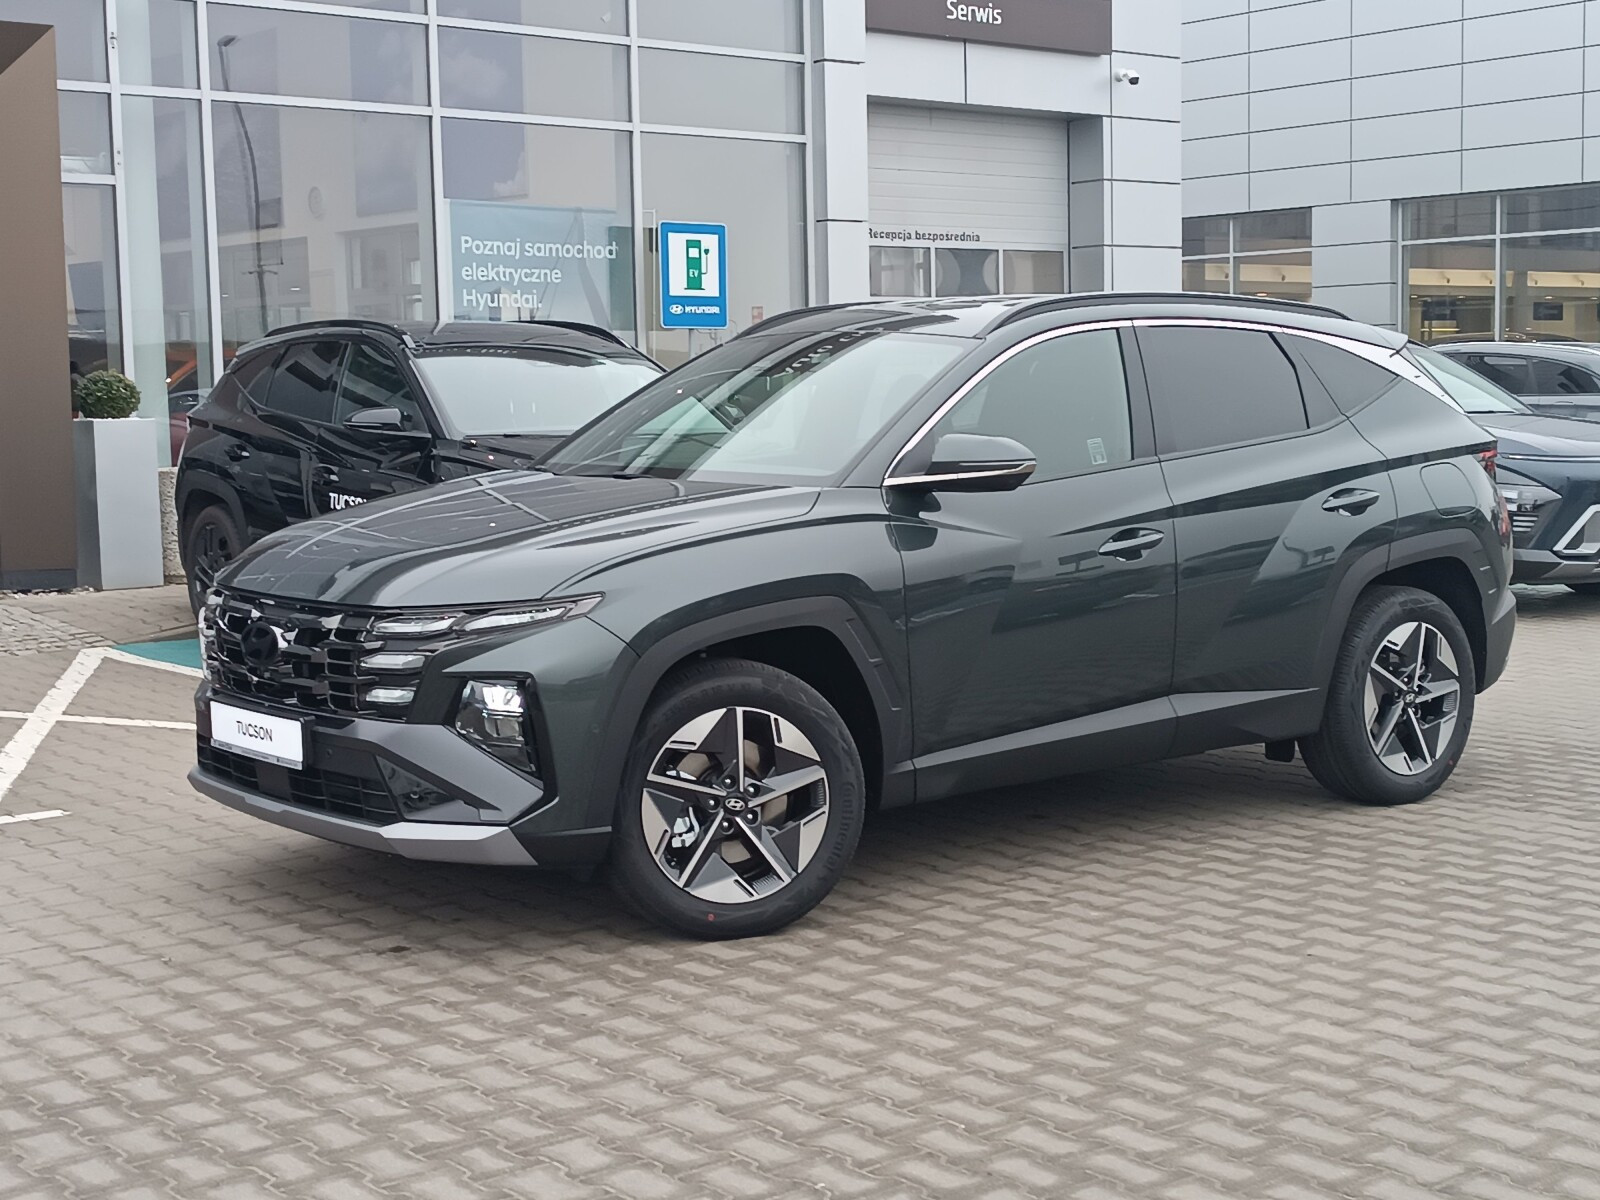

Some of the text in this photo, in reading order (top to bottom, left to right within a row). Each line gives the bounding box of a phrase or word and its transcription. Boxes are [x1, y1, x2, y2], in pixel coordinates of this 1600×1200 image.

[946, 0, 1002, 24] Serwis
[461, 236, 520, 260] Poznaj
[461, 262, 562, 286] elektryczne
[689, 268, 700, 278] EV
[463, 288, 543, 312] Hyundai.
[685, 304, 720, 314] HYUNDAI
[329, 492, 367, 510] TUCS
[236, 720, 273, 742] TUCSON
